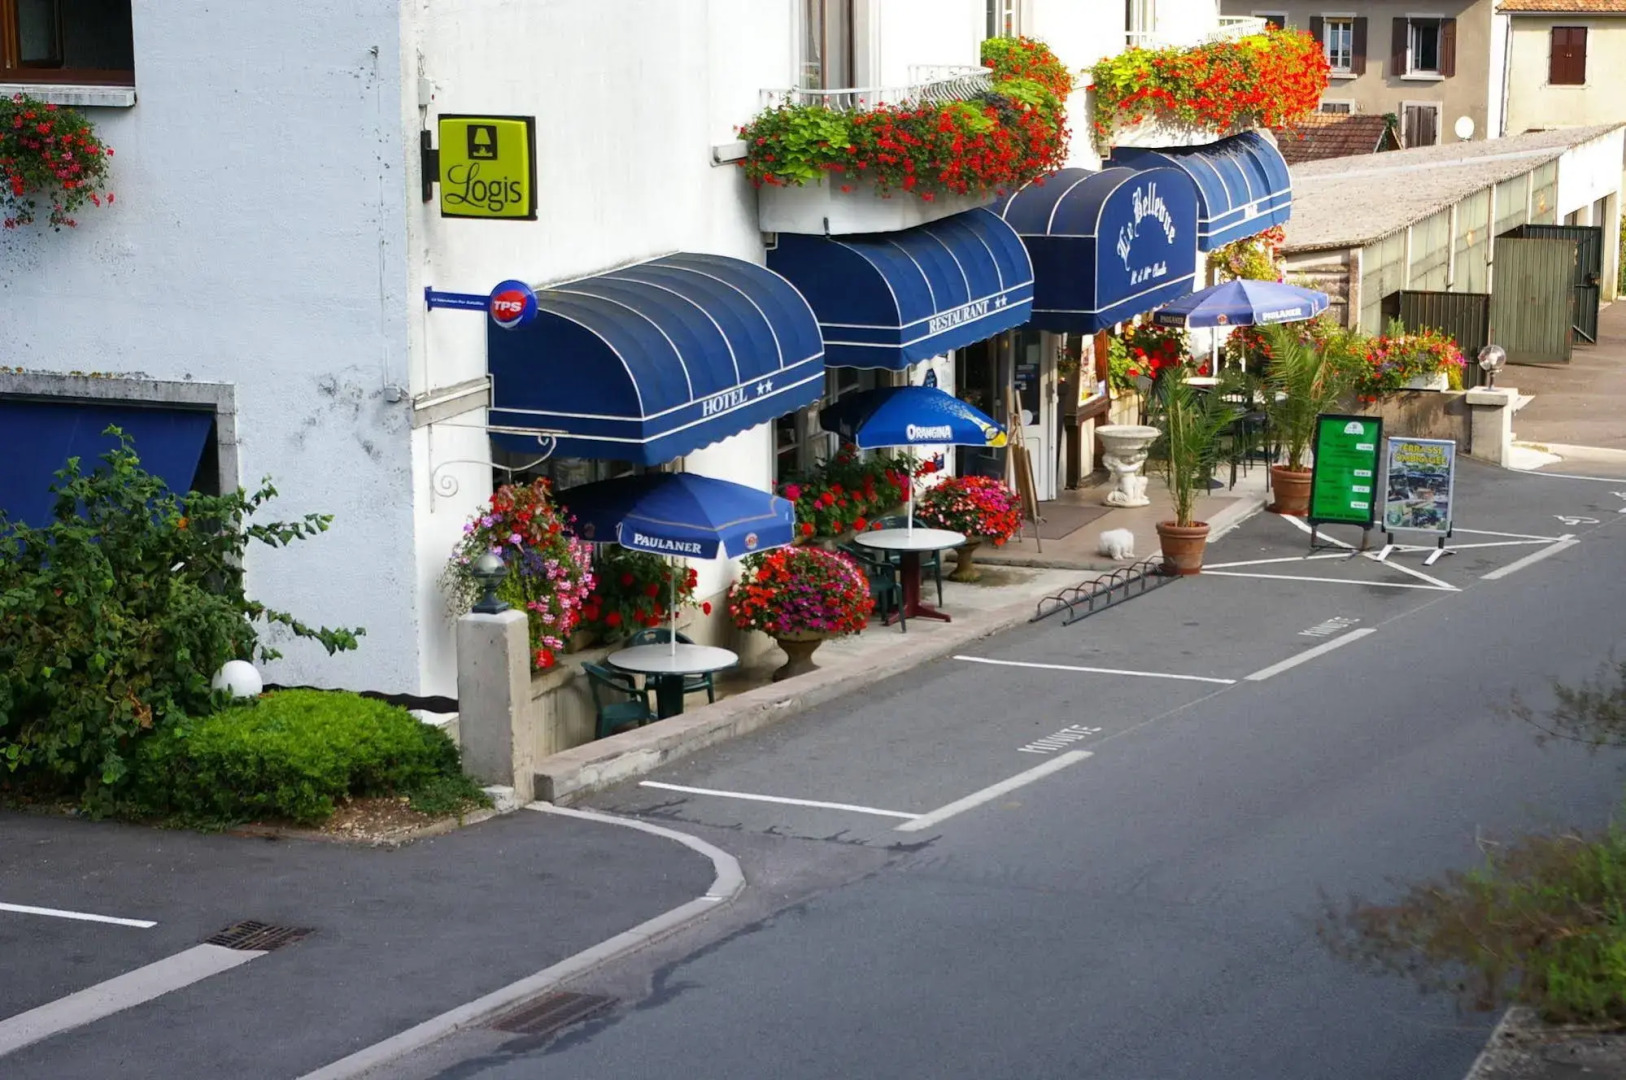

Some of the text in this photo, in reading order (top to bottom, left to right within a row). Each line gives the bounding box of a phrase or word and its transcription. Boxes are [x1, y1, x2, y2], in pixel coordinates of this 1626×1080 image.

[445, 163, 522, 212] Logis
[1132, 182, 1176, 245] Bellevue
[494, 299, 521, 313] TPS
[928, 300, 989, 334] RESTAURANT
[1262, 307, 1302, 321] PAULANER
[702, 388, 748, 417] HOTEL
[906, 424, 953, 442] ORANGINA
[633, 533, 702, 554] PAULANER
[1017, 724, 1102, 754] MINUTE
